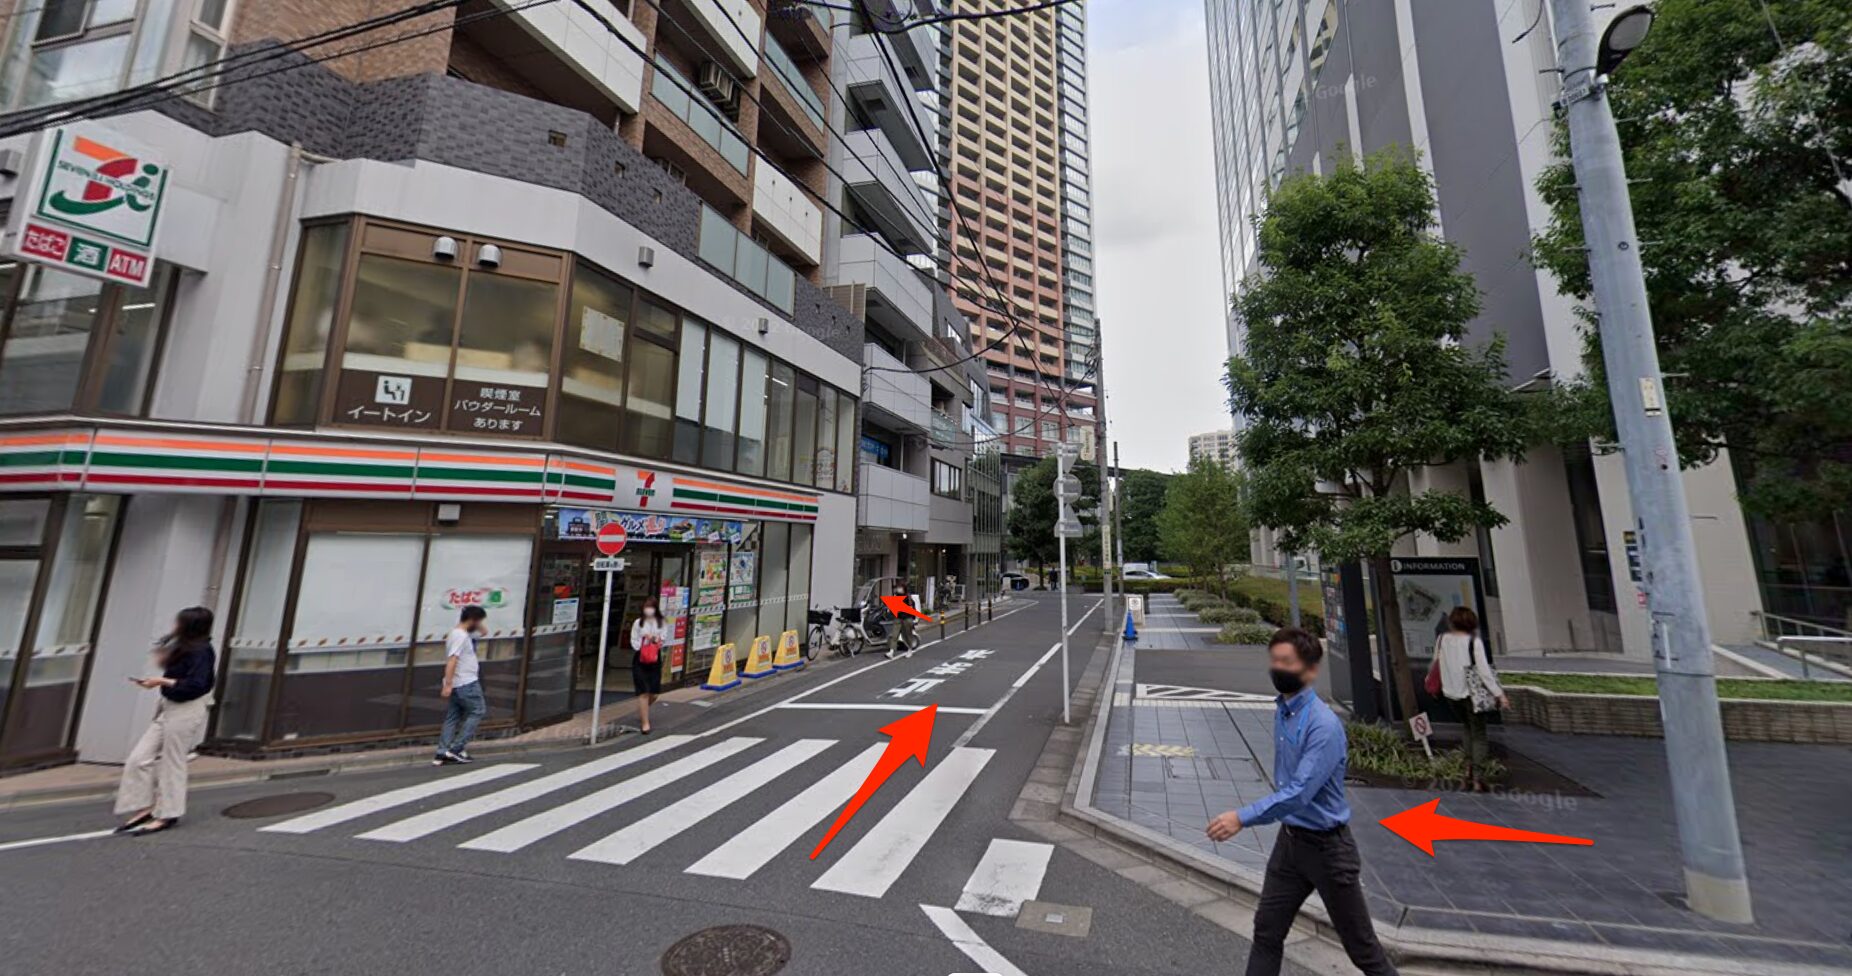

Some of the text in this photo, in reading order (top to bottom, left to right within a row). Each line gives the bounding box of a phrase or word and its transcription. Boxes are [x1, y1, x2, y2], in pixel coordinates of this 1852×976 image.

[26, 230, 66, 256] たばこ
[73, 242, 101, 266] 酒
[110, 254, 145, 278] ATM
[479, 387, 521, 401] 喫煙室
[347, 405, 432, 424] イートイン
[453, 399, 542, 418] パウダールーム
[472, 416, 524, 432] あります
[1403, 561, 1466, 571] INFORMATION
[449, 591, 482, 604] たばこ
